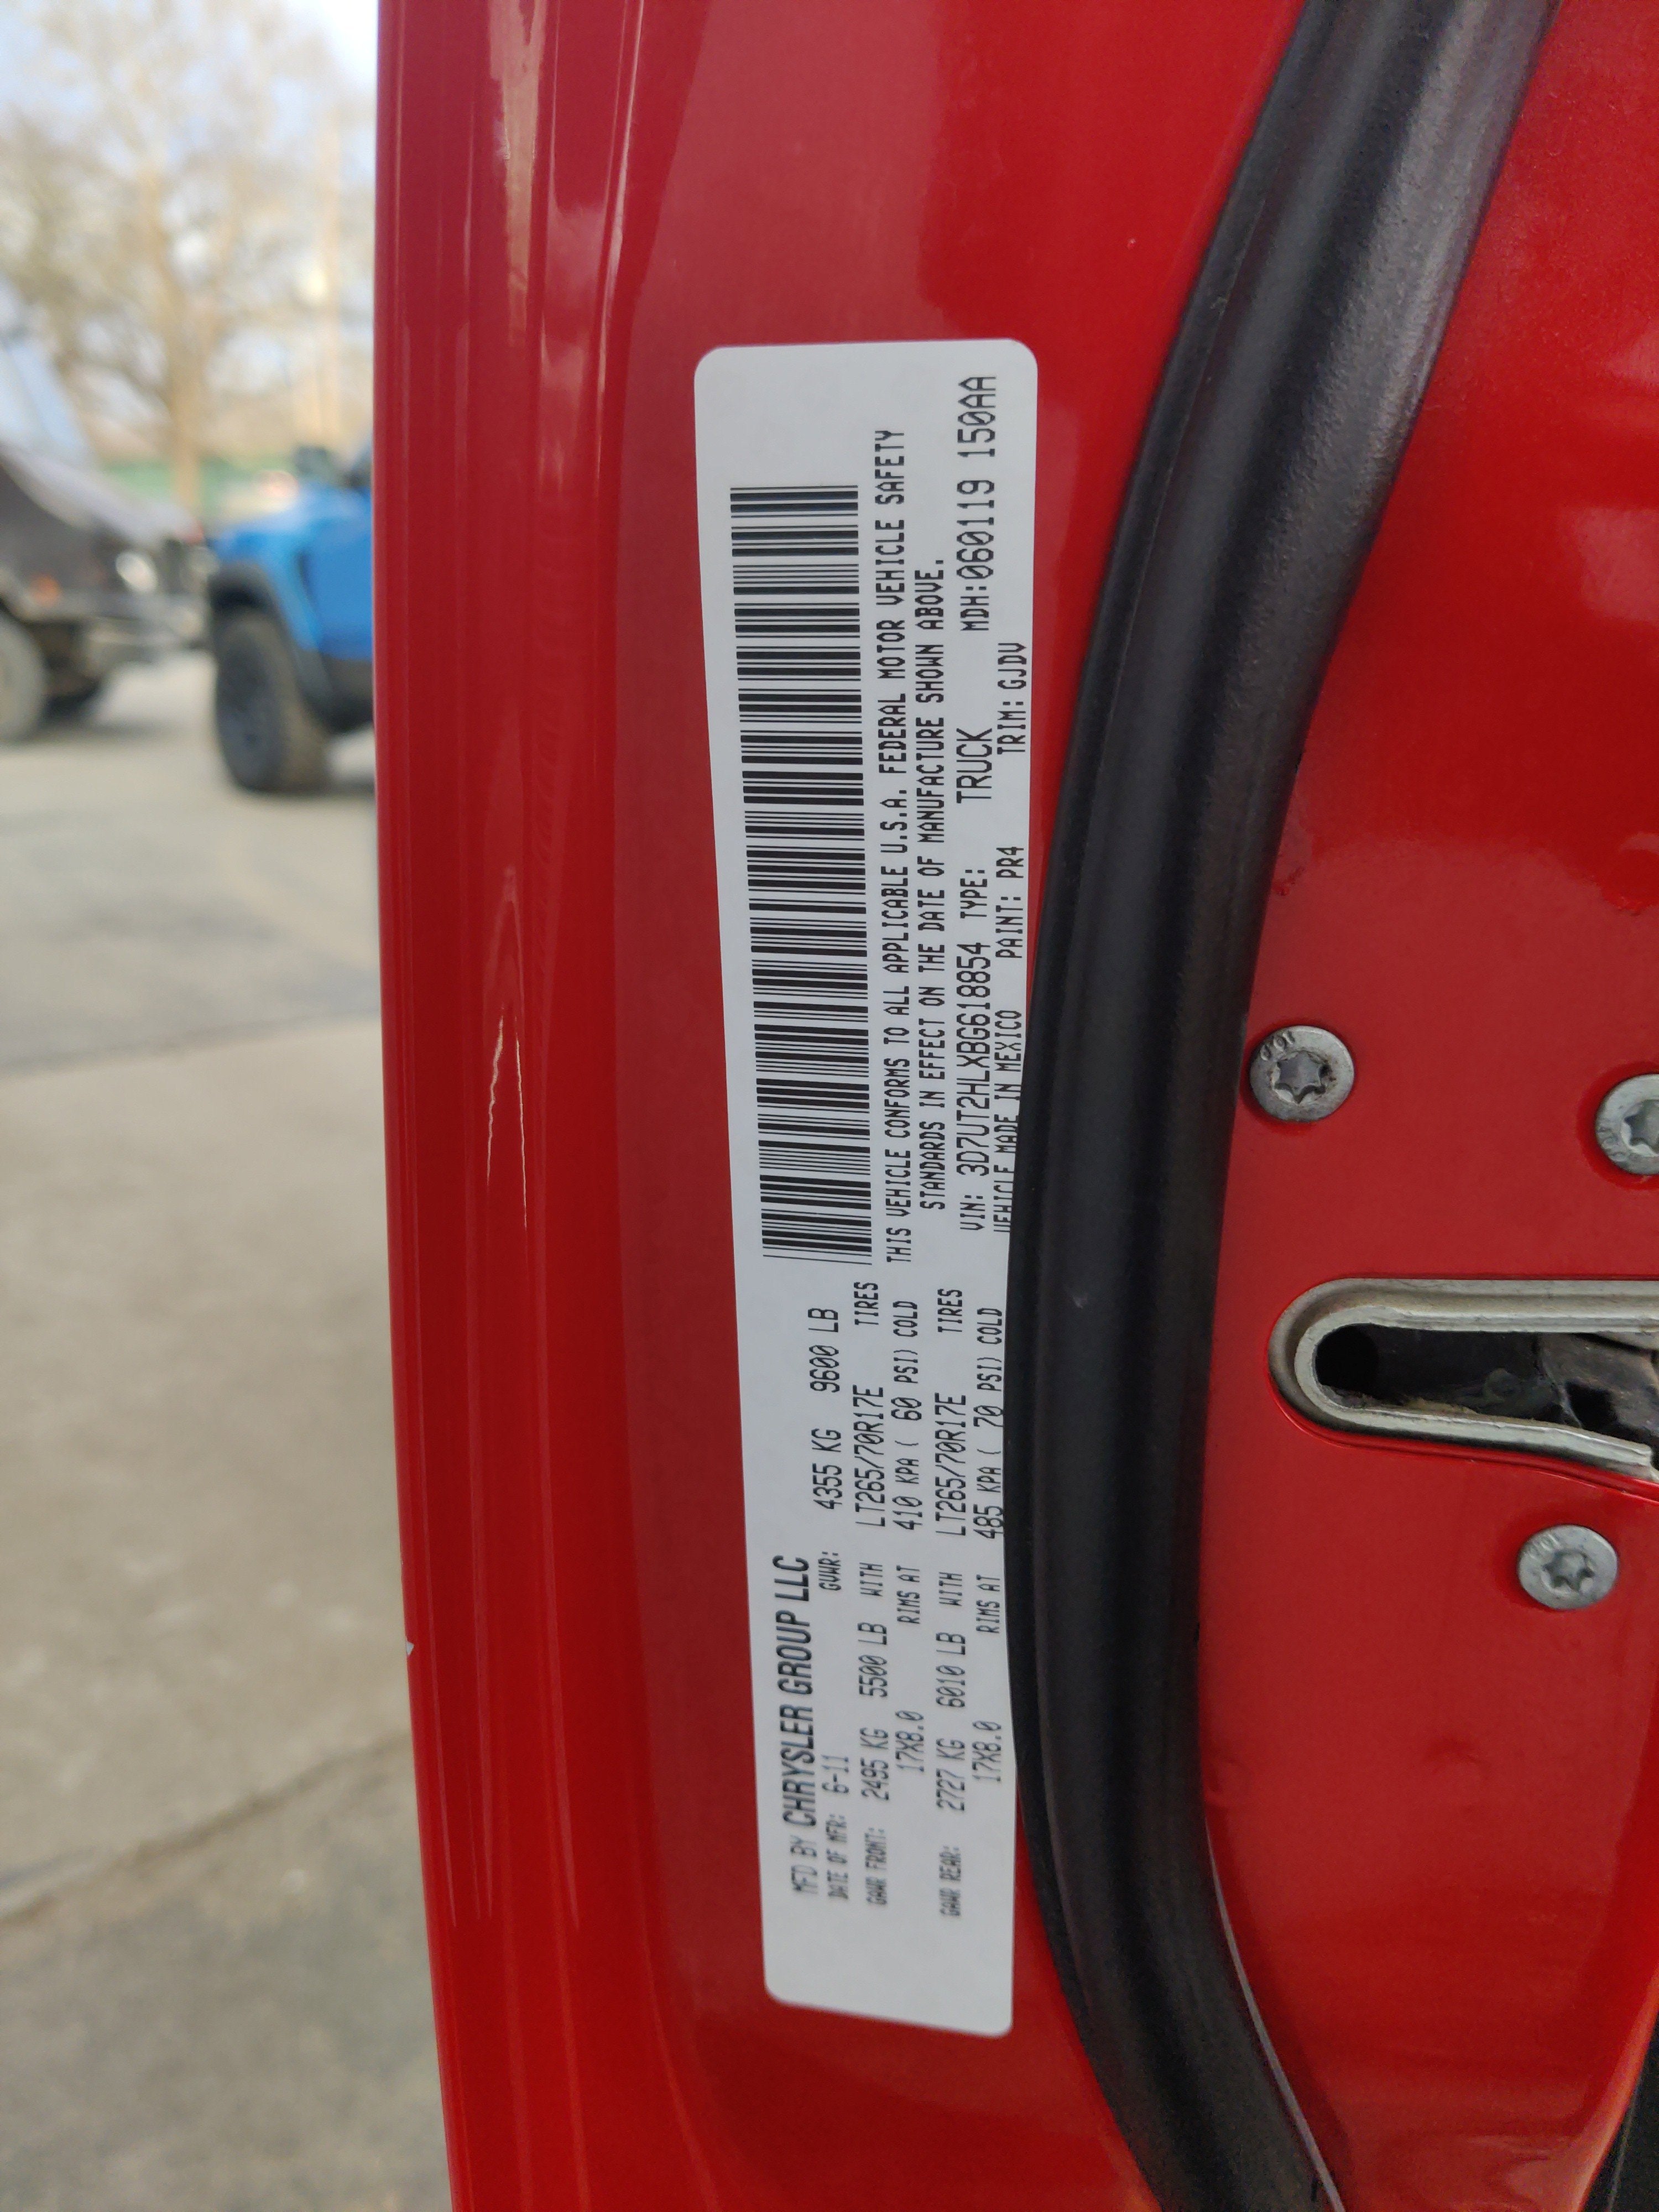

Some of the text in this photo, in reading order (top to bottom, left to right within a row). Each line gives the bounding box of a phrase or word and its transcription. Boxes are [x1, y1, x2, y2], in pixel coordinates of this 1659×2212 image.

[957, 375, 996, 457] 150AA
[997, 642, 1027, 689] GJDV
[997, 701, 1026, 754] TRIM:
[956, 727, 993, 804] TRUCK
[874, 430, 911, 1262] THIS VEHICLE CONFORMS TO ALL APPLICABLE U.S.A. FEDERAL MOTOR VEHICLE SAFETY
[995, 846, 1025, 878] PR4
[914, 559, 946, 1209] STANDARDS IN EFFECT ON THE DATE OF MANUFACTURE SHOWN ABOVE.
[959, 869, 988, 919] TYPE:
[995, 895, 1024, 958] PAINT:
[956, 941, 991, 1176] 3D7UT2HLXBG618854
[994, 1009, 1022, 1072] MEXICO
[994, 1082, 1022, 1101] IN
[993, 1113, 1019, 1153] MADE
[959, 1194, 986, 1230] VIN:
[853, 1281, 879, 1325] TIRES
[892, 1300, 918, 1337] COLD
[937, 1288, 963, 1332] TIRES
[976, 1307, 1003, 1344] COLD
[890, 1396, 922, 1421] 60
[973, 1404, 1003, 1427] 70
[807, 1307, 843, 1590] GVWR: 4355 KG 9600 LB
[852, 1384, 885, 1527] LT265/70R17E
[934, 1391, 966, 1536] LT265/70R17E
[894, 1457, 920, 1484] KPA
[976, 1466, 1001, 1493] KPA
[891, 1495, 923, 1530] 410
[973, 1503, 1003, 1539] 485
[772, 1554, 810, 1601] LLC
[859, 1562, 883, 1597] WITH
[896, 1564, 920, 1583] AT
[938, 1571, 963, 1606] WITH
[975, 1573, 1000, 1592] AT
[896, 1589, 921, 1624] RIMS
[975, 1599, 1000, 1634] RIMS
[775, 1609, 813, 1695] GROUP
[857, 1621, 888, 1645] LB
[935, 1631, 966, 1655] LB
[858, 1654, 888, 1698] 5500
[935, 1664, 966, 1708] 6010
[859, 1726, 889, 1750] KG
[895, 1710, 925, 1772] 17X8.0
[936, 1738, 966, 1760] KG
[971, 1720, 1001, 1782] 17X8.0
[779, 1704, 817, 1827] CHRYSLER
[821, 1755, 850, 1794] 6-11
[860, 1757, 890, 1801] 2495
[935, 1767, 966, 1811] 2727
[789, 1836, 818, 1858] BY
[826, 1848, 848, 1865] OF
[826, 1869, 849, 1900] DATE
